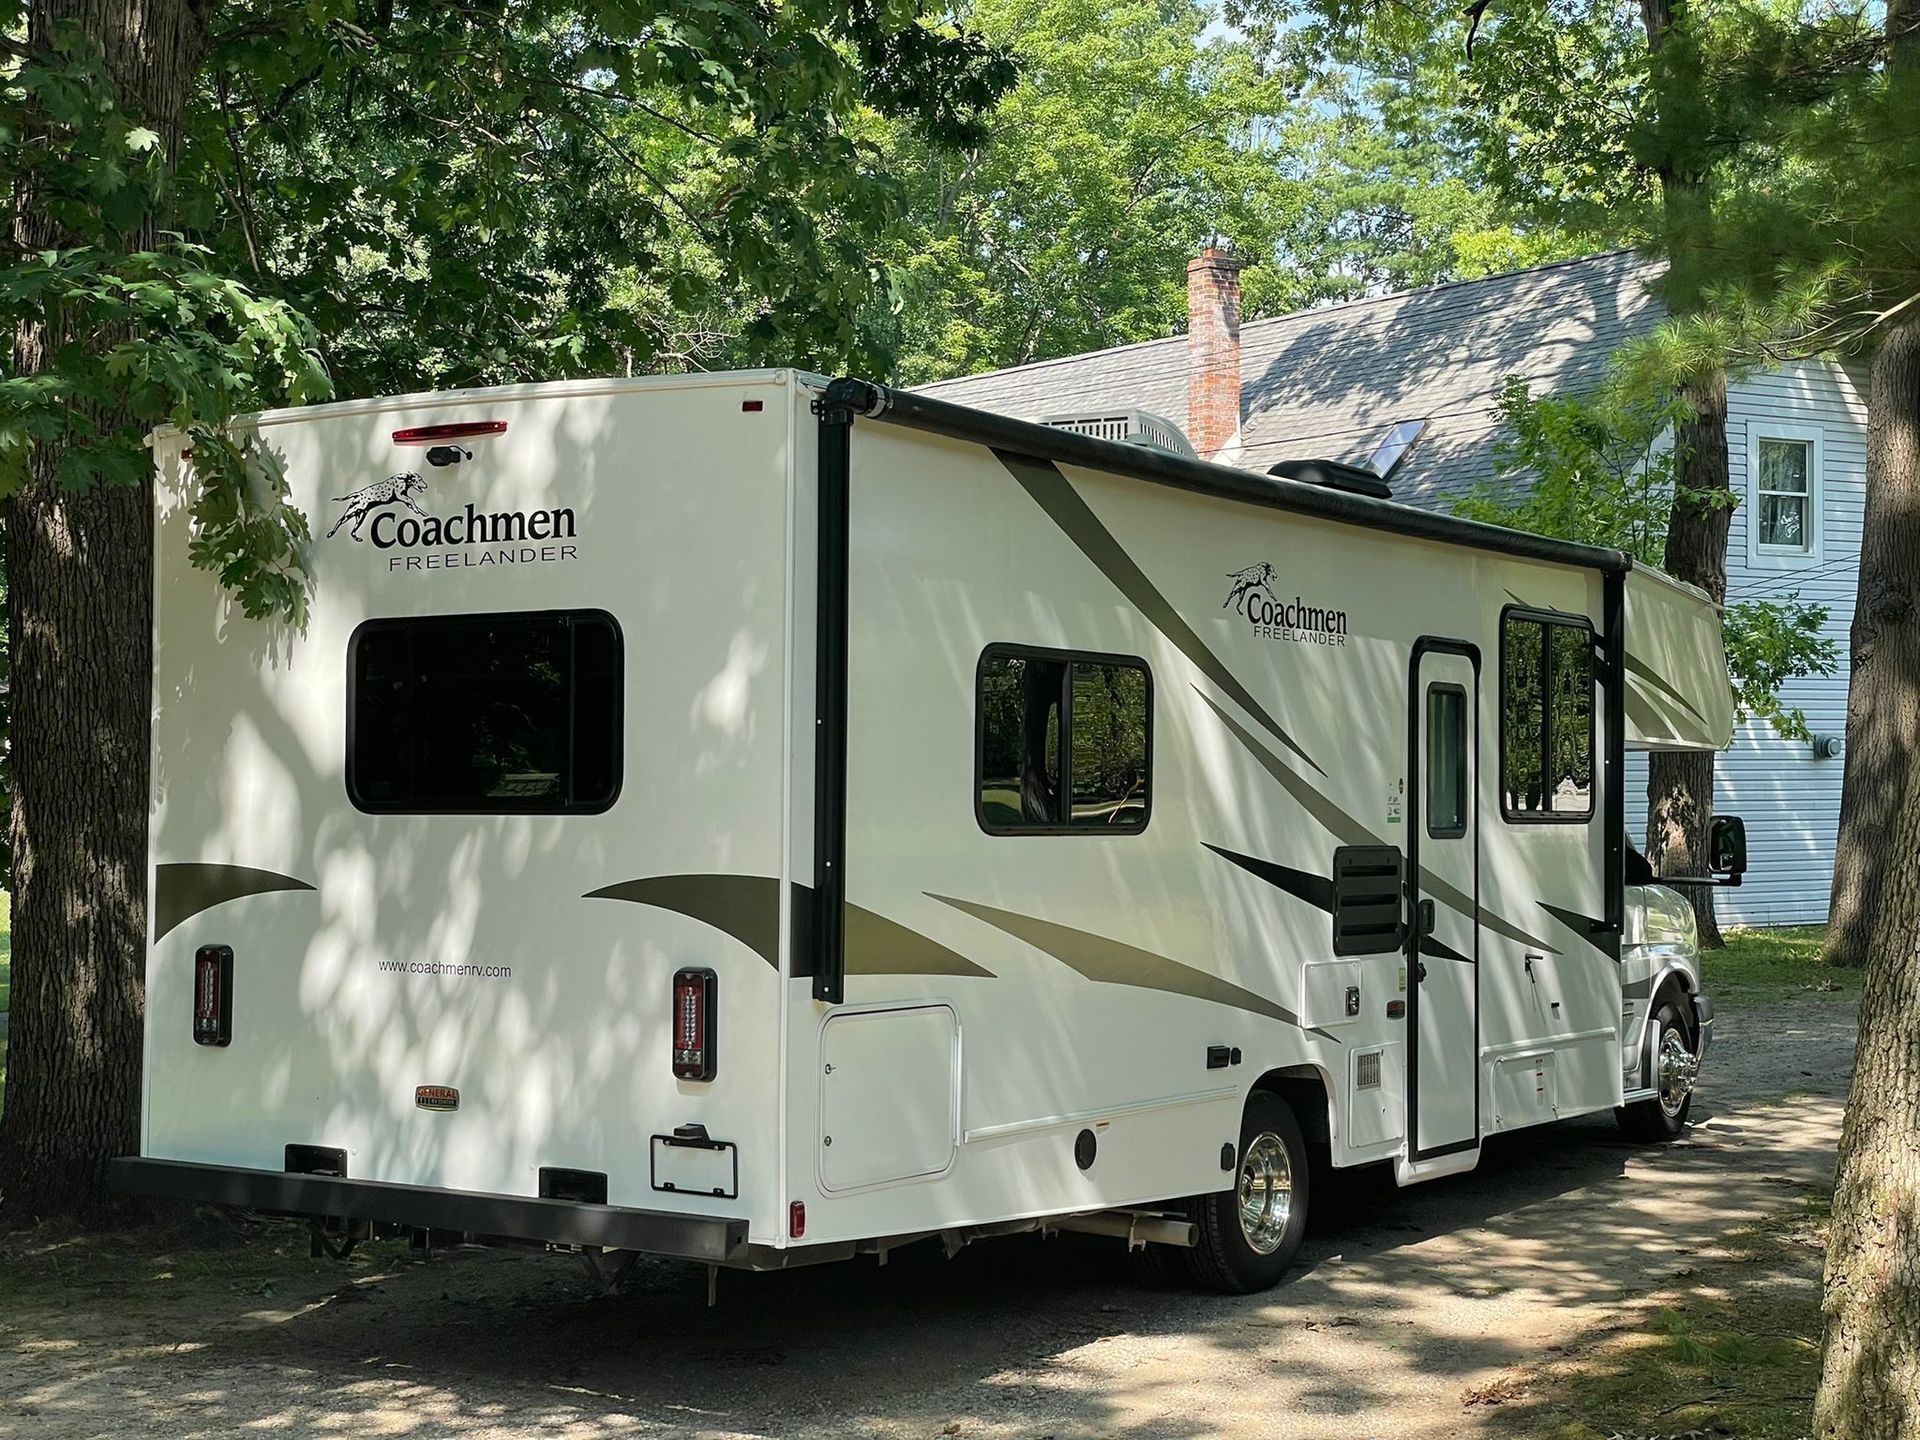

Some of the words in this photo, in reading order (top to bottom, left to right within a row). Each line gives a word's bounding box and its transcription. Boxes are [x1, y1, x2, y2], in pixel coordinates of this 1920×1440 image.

[370, 503, 577, 549] Coachmen
[389, 545, 578, 572] FREELANDER
[1247, 593, 1348, 635] Coachmen
[1253, 626, 1346, 647] FREELANDER
[378, 960, 512, 978] www.coachmenrv.com
[417, 1087, 457, 1099] GENERAL
